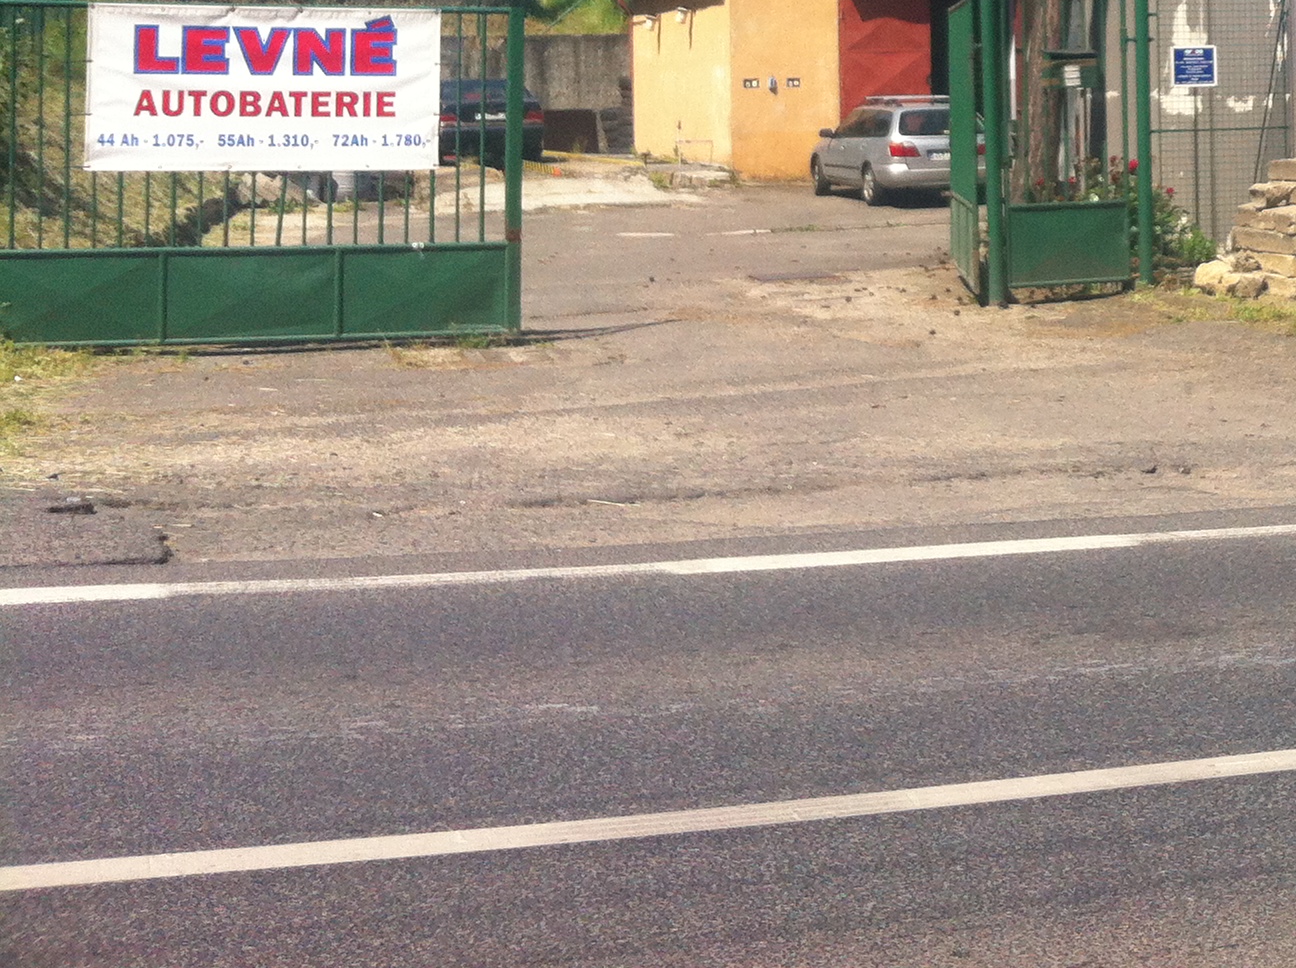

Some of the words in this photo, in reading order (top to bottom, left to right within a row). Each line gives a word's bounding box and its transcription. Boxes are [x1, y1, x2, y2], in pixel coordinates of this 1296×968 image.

[133, 15, 398, 76] LEVNÉ
[133, 89, 396, 117] AUTOBATERIE
[97, 133, 115, 147] 44
[120, 133, 139, 147] Ah
[217, 134, 255, 147] 55Ah
[332, 134, 368, 147] 72Ah
